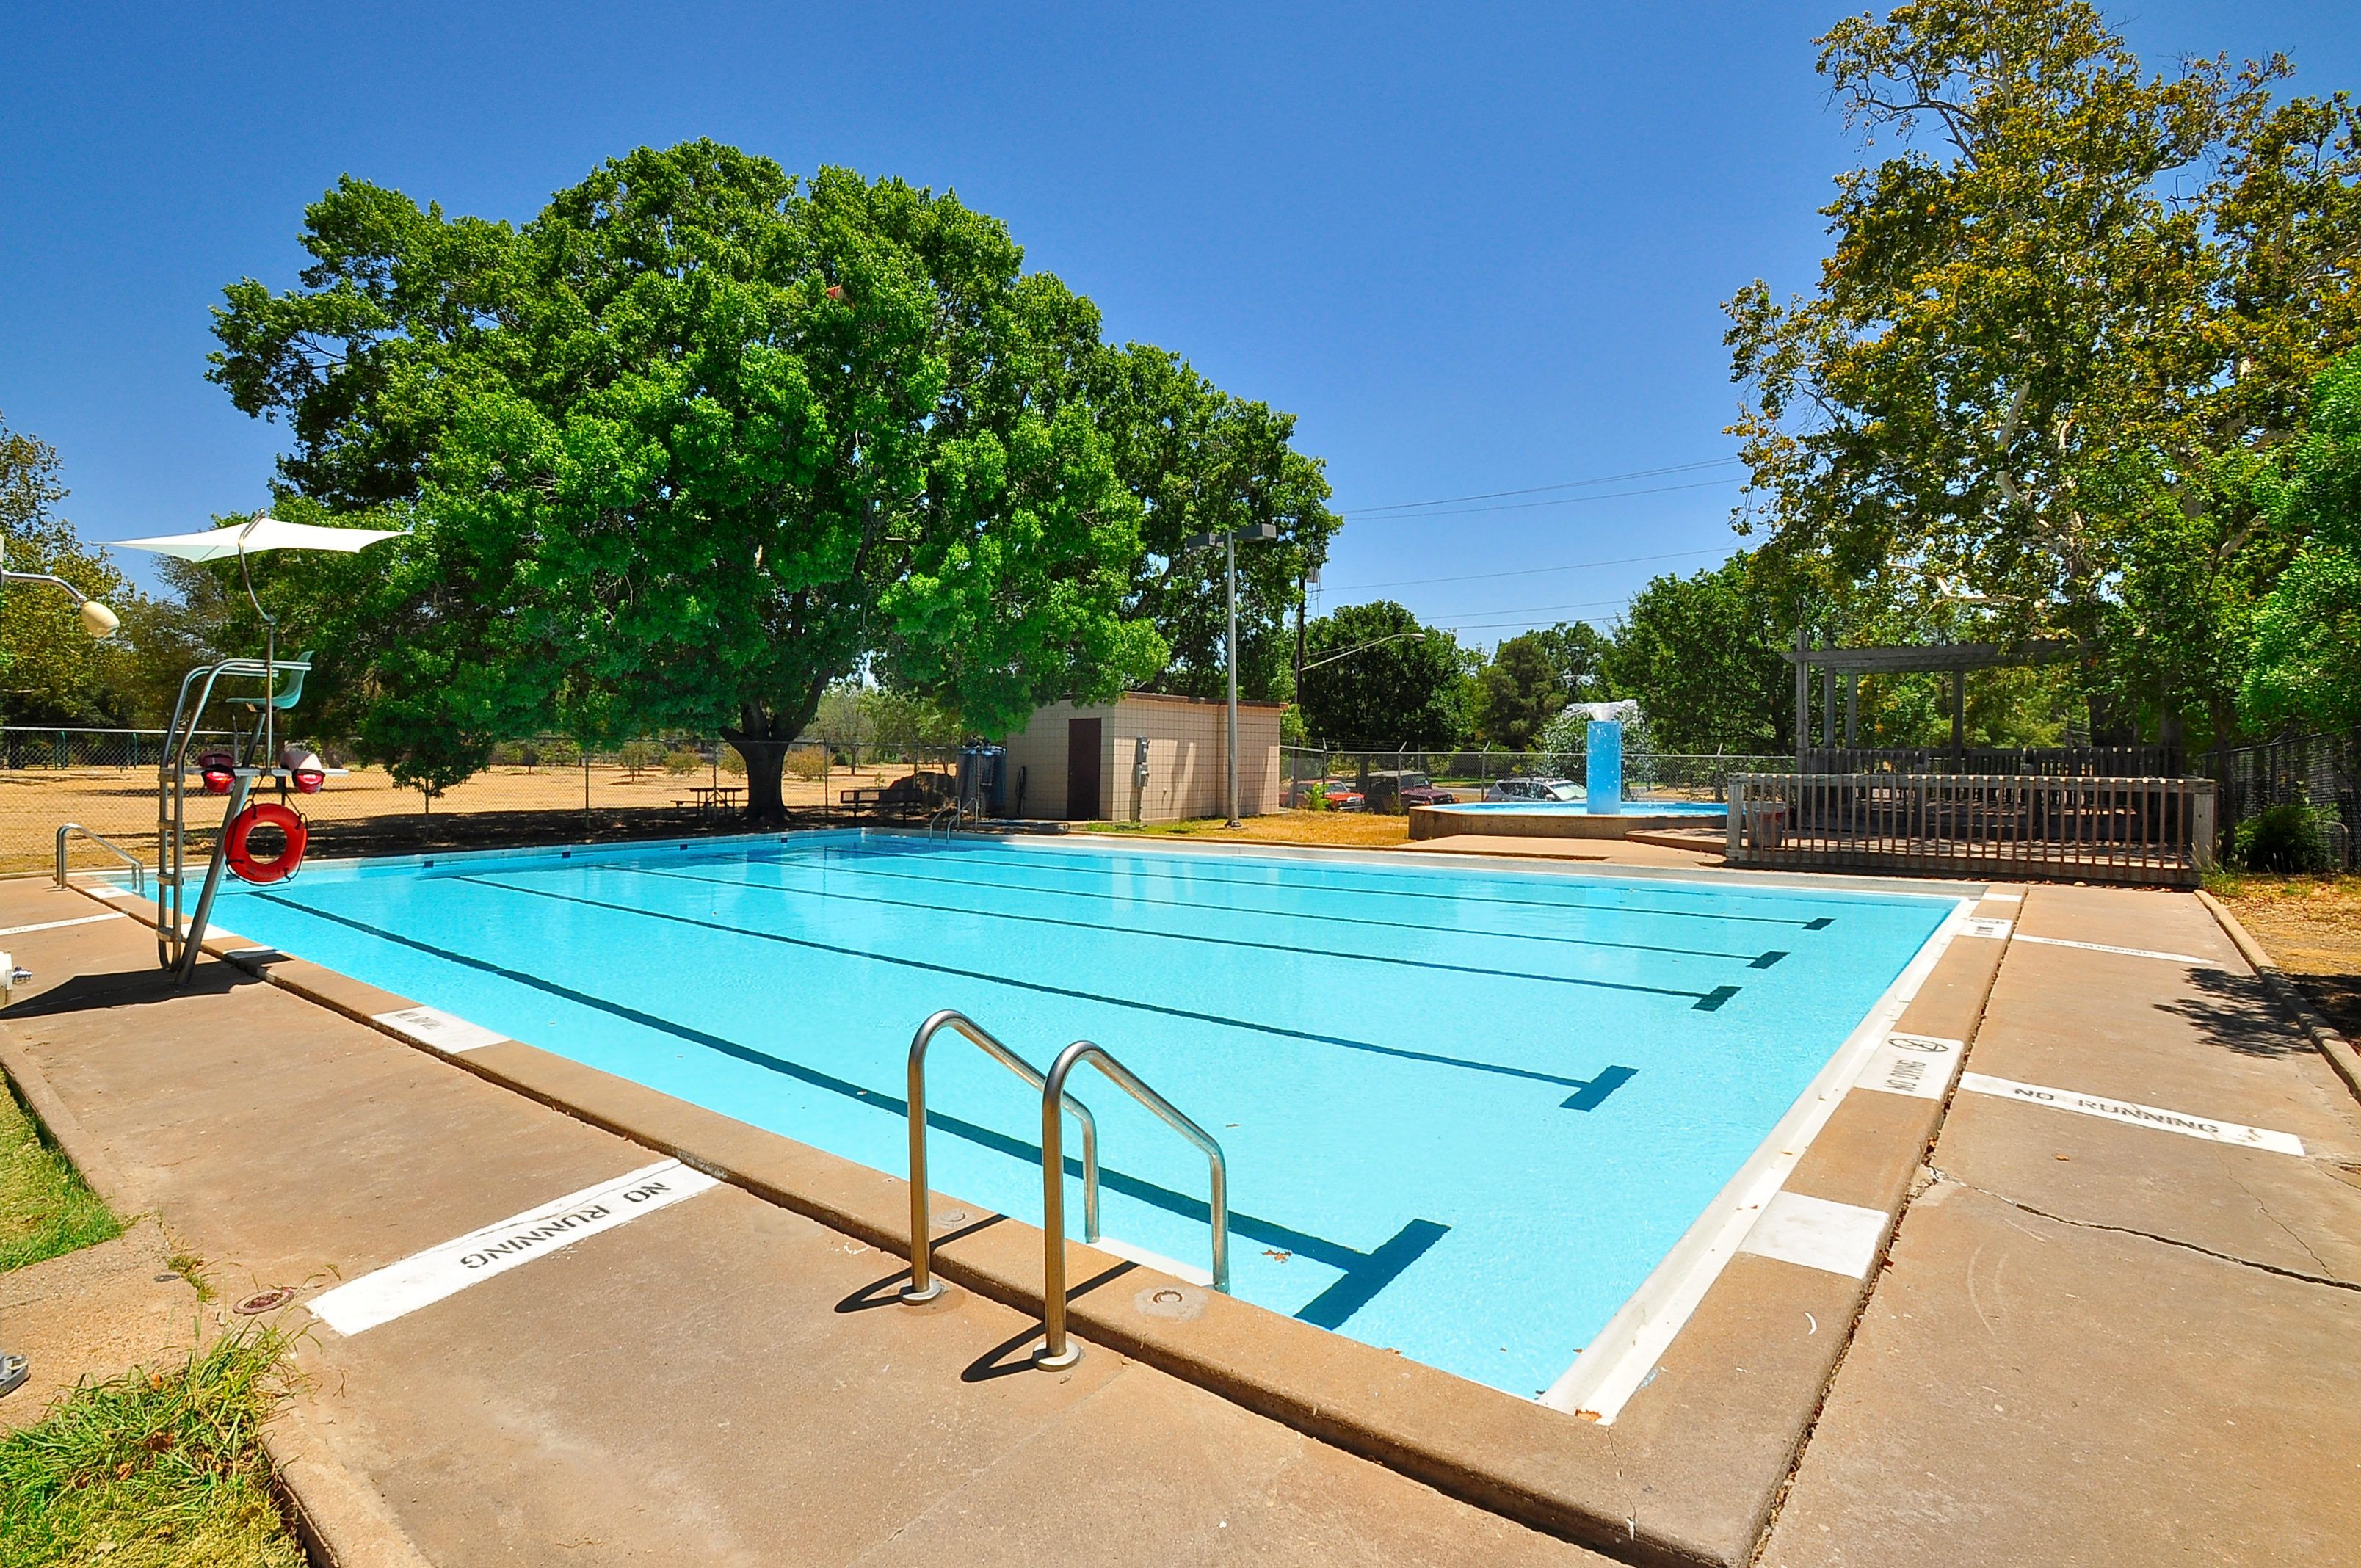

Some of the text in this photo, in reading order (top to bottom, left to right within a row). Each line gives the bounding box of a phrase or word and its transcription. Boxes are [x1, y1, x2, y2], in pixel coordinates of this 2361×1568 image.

[1884, 1059, 1927, 1092] NO DIVING
[2014, 1088, 2219, 1133] NO RUNNING
[460, 1182, 671, 1268] NO RUNNING
